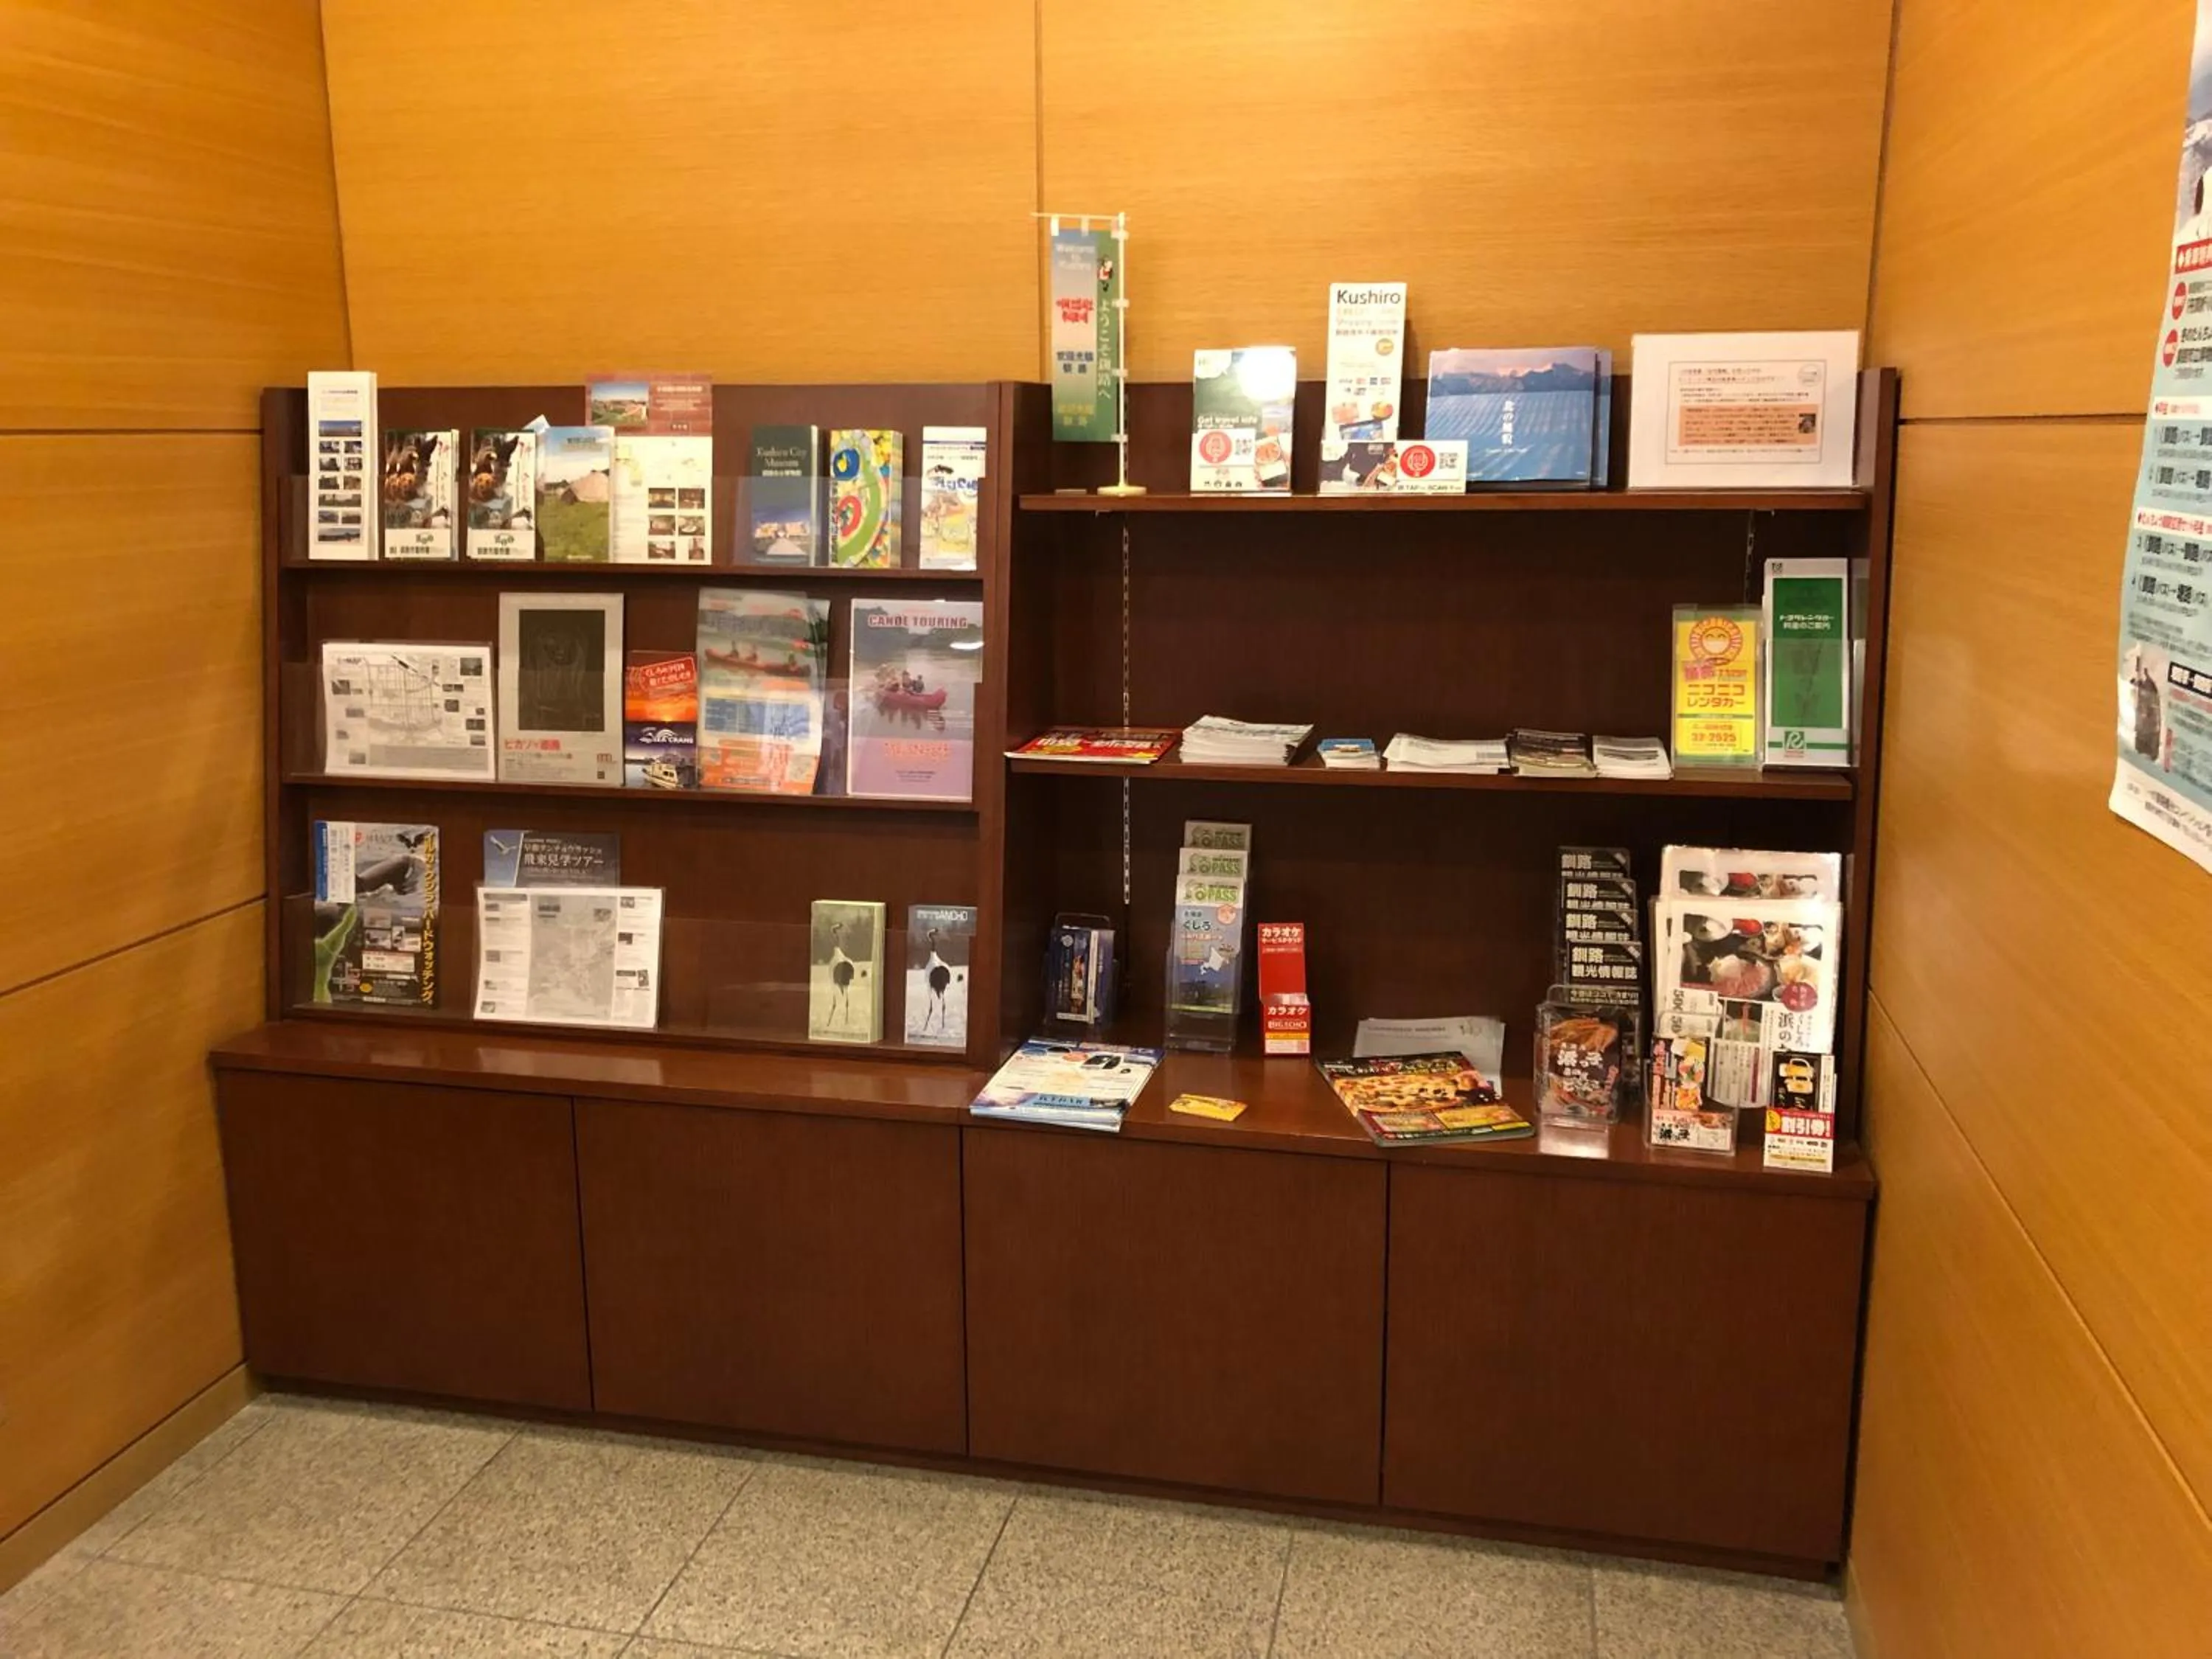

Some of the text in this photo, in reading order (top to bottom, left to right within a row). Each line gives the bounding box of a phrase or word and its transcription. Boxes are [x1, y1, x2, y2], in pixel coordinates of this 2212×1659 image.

[1337, 288, 1401, 305] Kushiro
[913, 616, 968, 628] TOURING
[1687, 684, 1745, 696] ニコニコ
[1686, 698, 1745, 708] レンタカー
[1211, 862, 1240, 874] PASS
[1208, 888, 1237, 902] PASS
[1183, 919, 1211, 931] くしろ
[1262, 927, 1301, 937] カラオケ
[1572, 947, 1604, 964] 釧路
[1267, 1006, 1307, 1015] カラオケ
